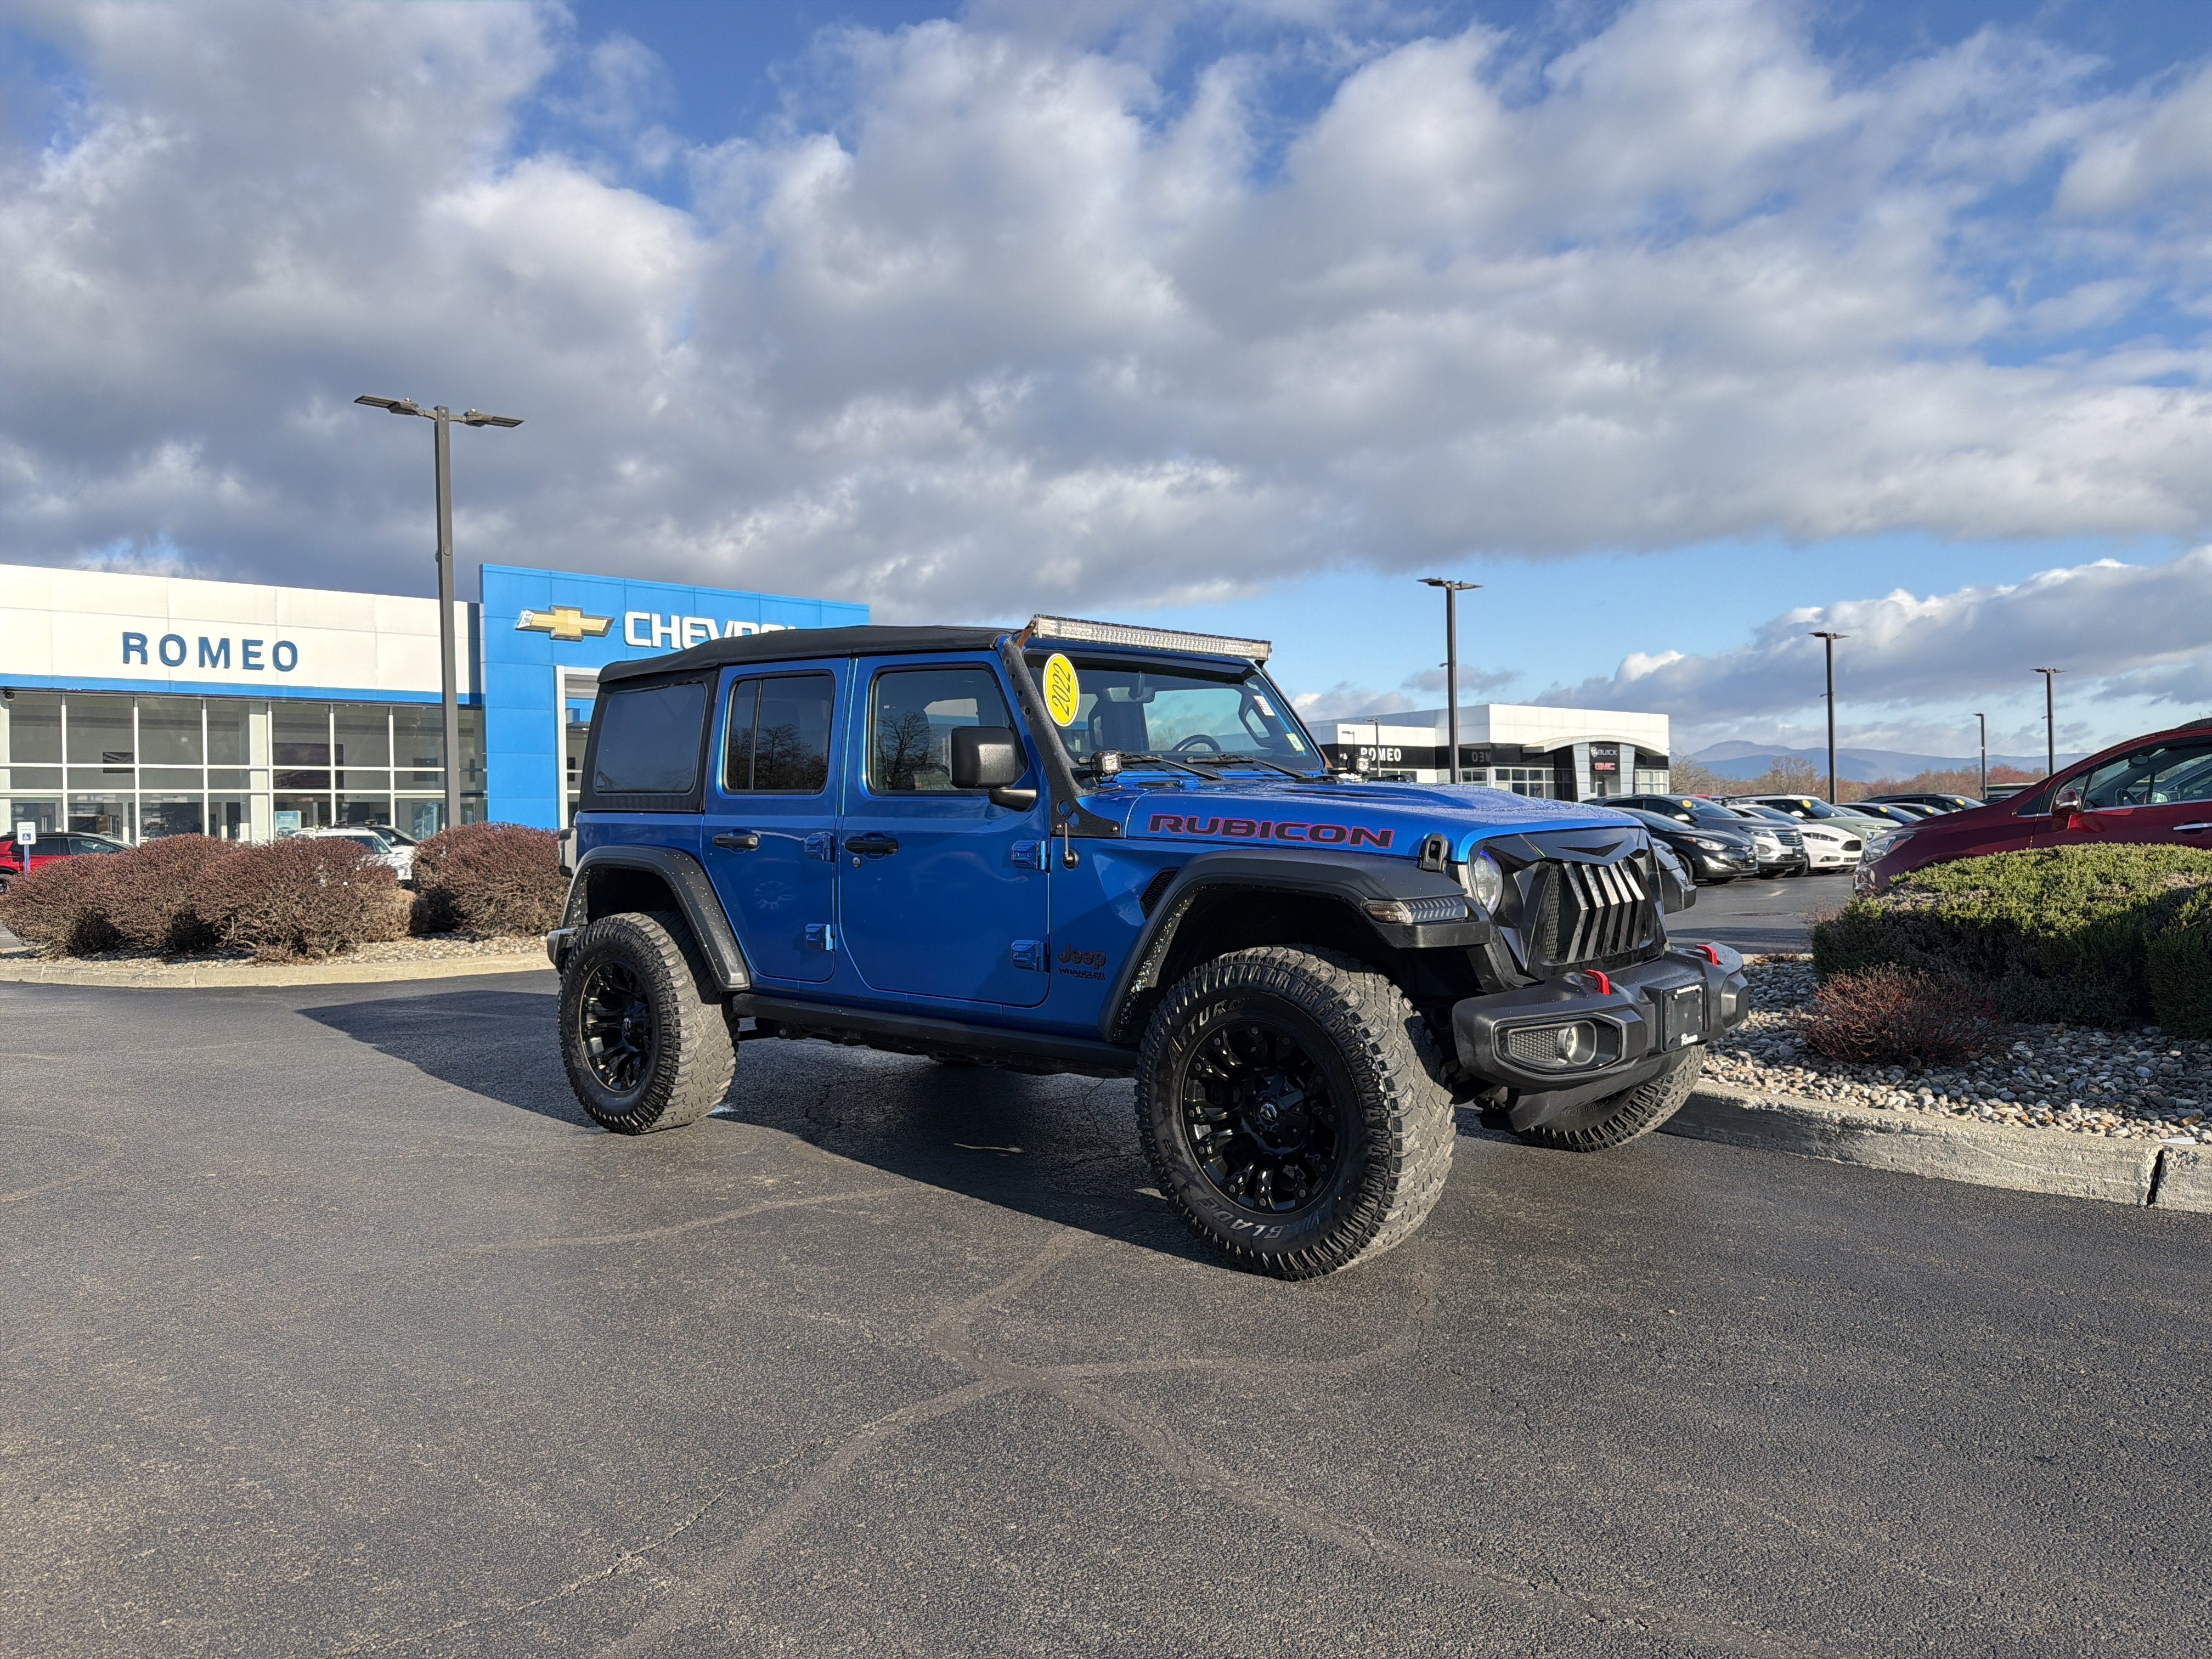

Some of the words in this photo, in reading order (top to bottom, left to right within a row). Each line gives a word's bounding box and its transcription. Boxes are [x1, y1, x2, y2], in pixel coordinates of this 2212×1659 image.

[122, 631, 298, 672] ROMEO
[1052, 662, 1071, 717] 2022
[1361, 747, 1402, 762] ROMEO
[1148, 814, 1394, 848] RUBICON
[1058, 943, 1106, 970] Jeep
[1058, 967, 1105, 978] WRANGLER
[1195, 1197, 1283, 1239] BLADE
